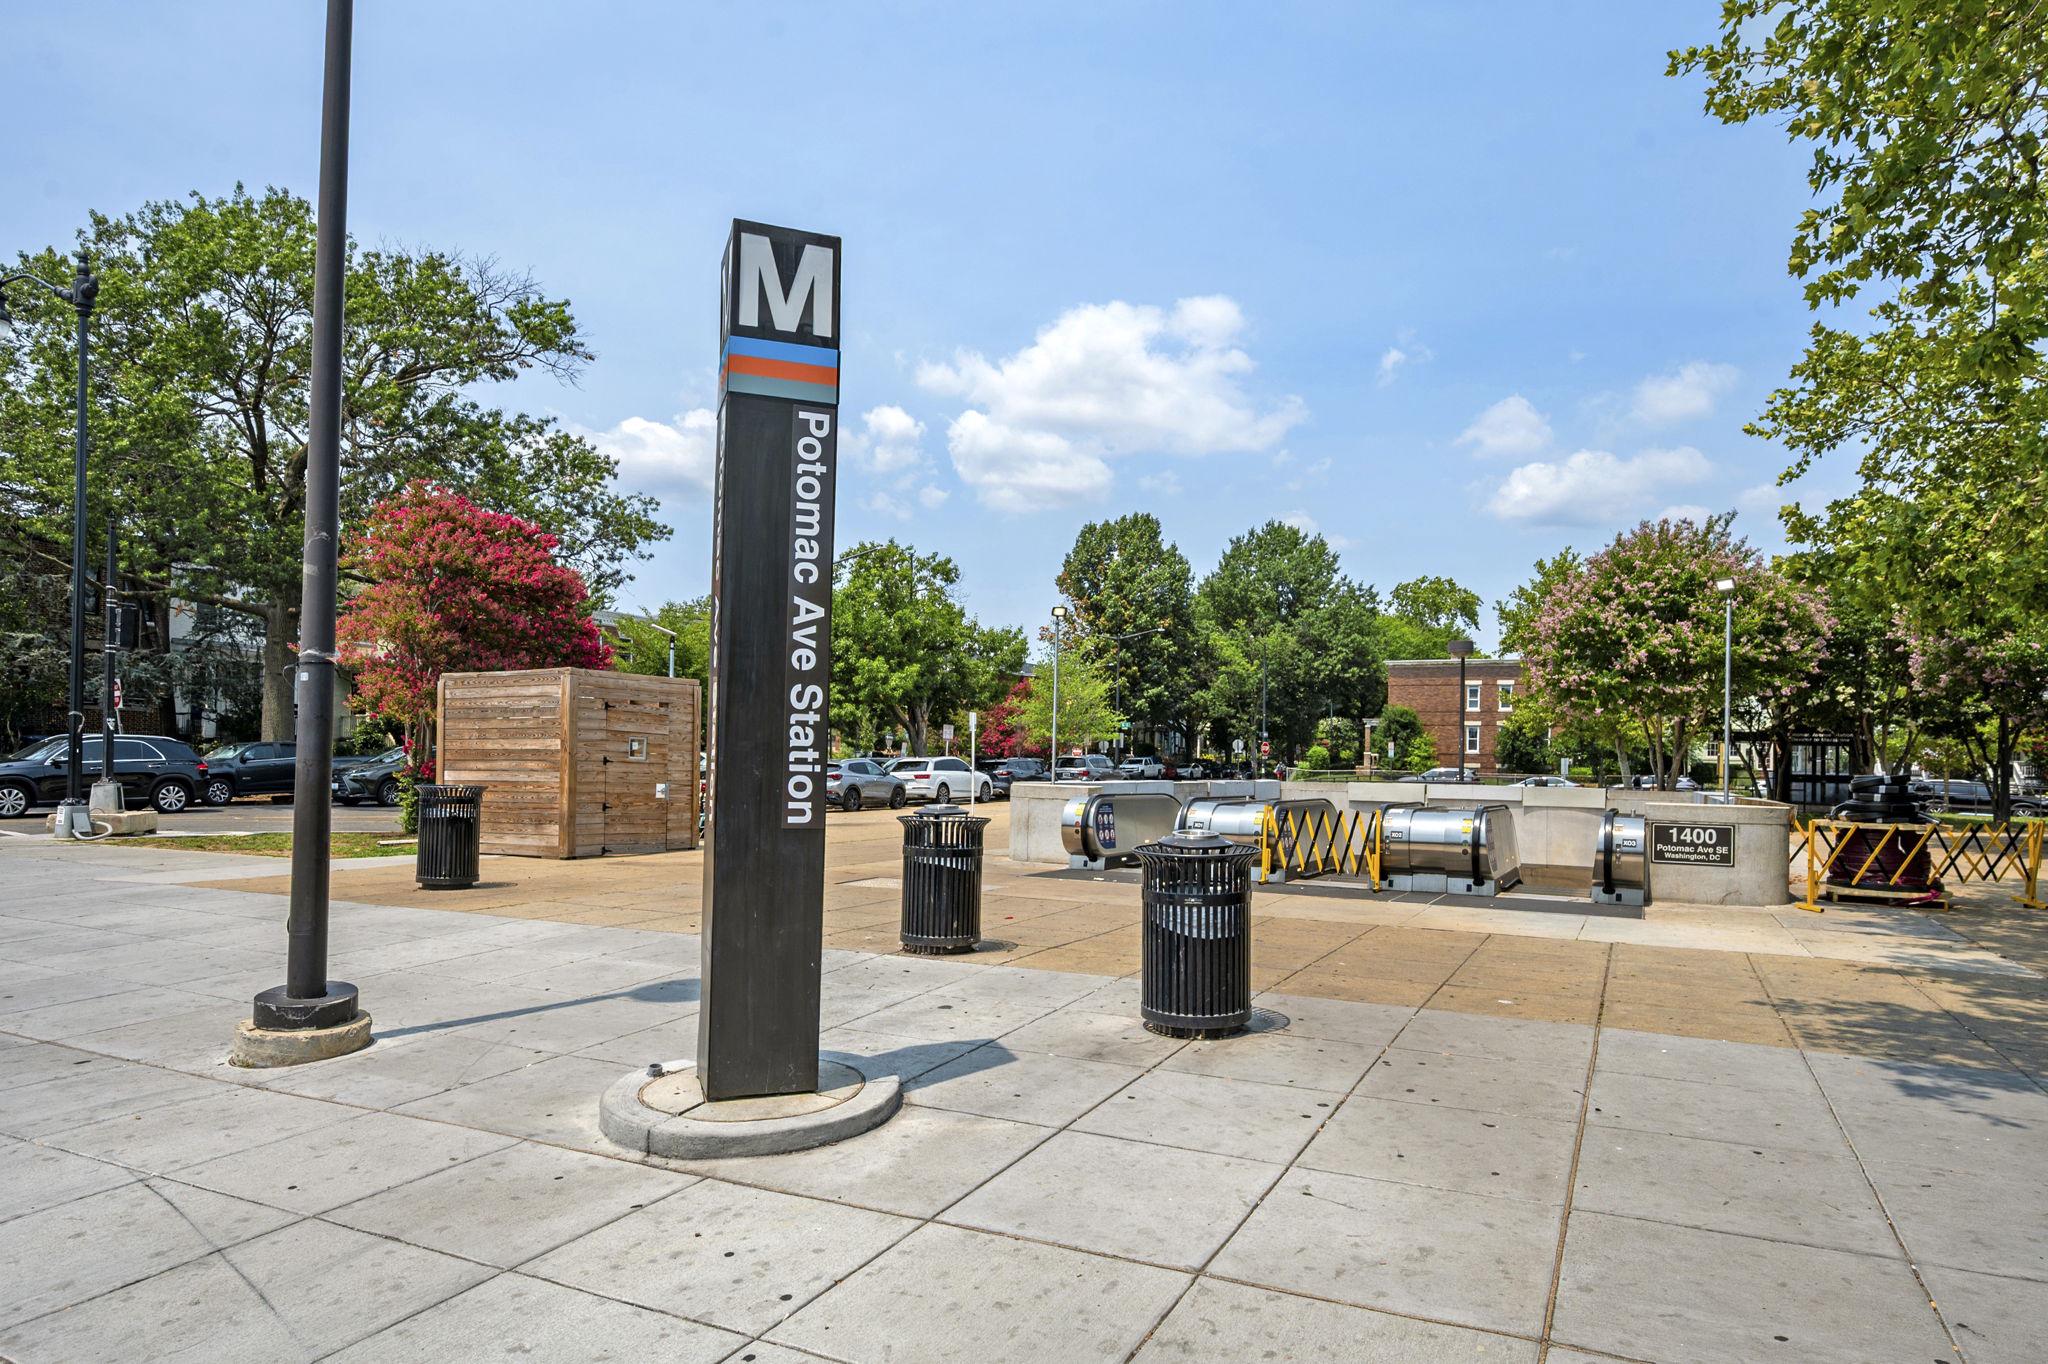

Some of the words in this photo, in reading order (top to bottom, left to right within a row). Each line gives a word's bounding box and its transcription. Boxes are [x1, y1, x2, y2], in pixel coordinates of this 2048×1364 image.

[739, 232, 834, 338] M
[793, 411, 830, 584] Potomac
[791, 595, 825, 671] Ave
[787, 683, 824, 824] Station
[1656, 843, 1695, 853] Potomac
[1697, 845, 1714, 854] Ave
[1716, 846, 1729, 855] SE
[1664, 852, 1708, 861] Washington,
[1669, 827, 1717, 845] 1400
